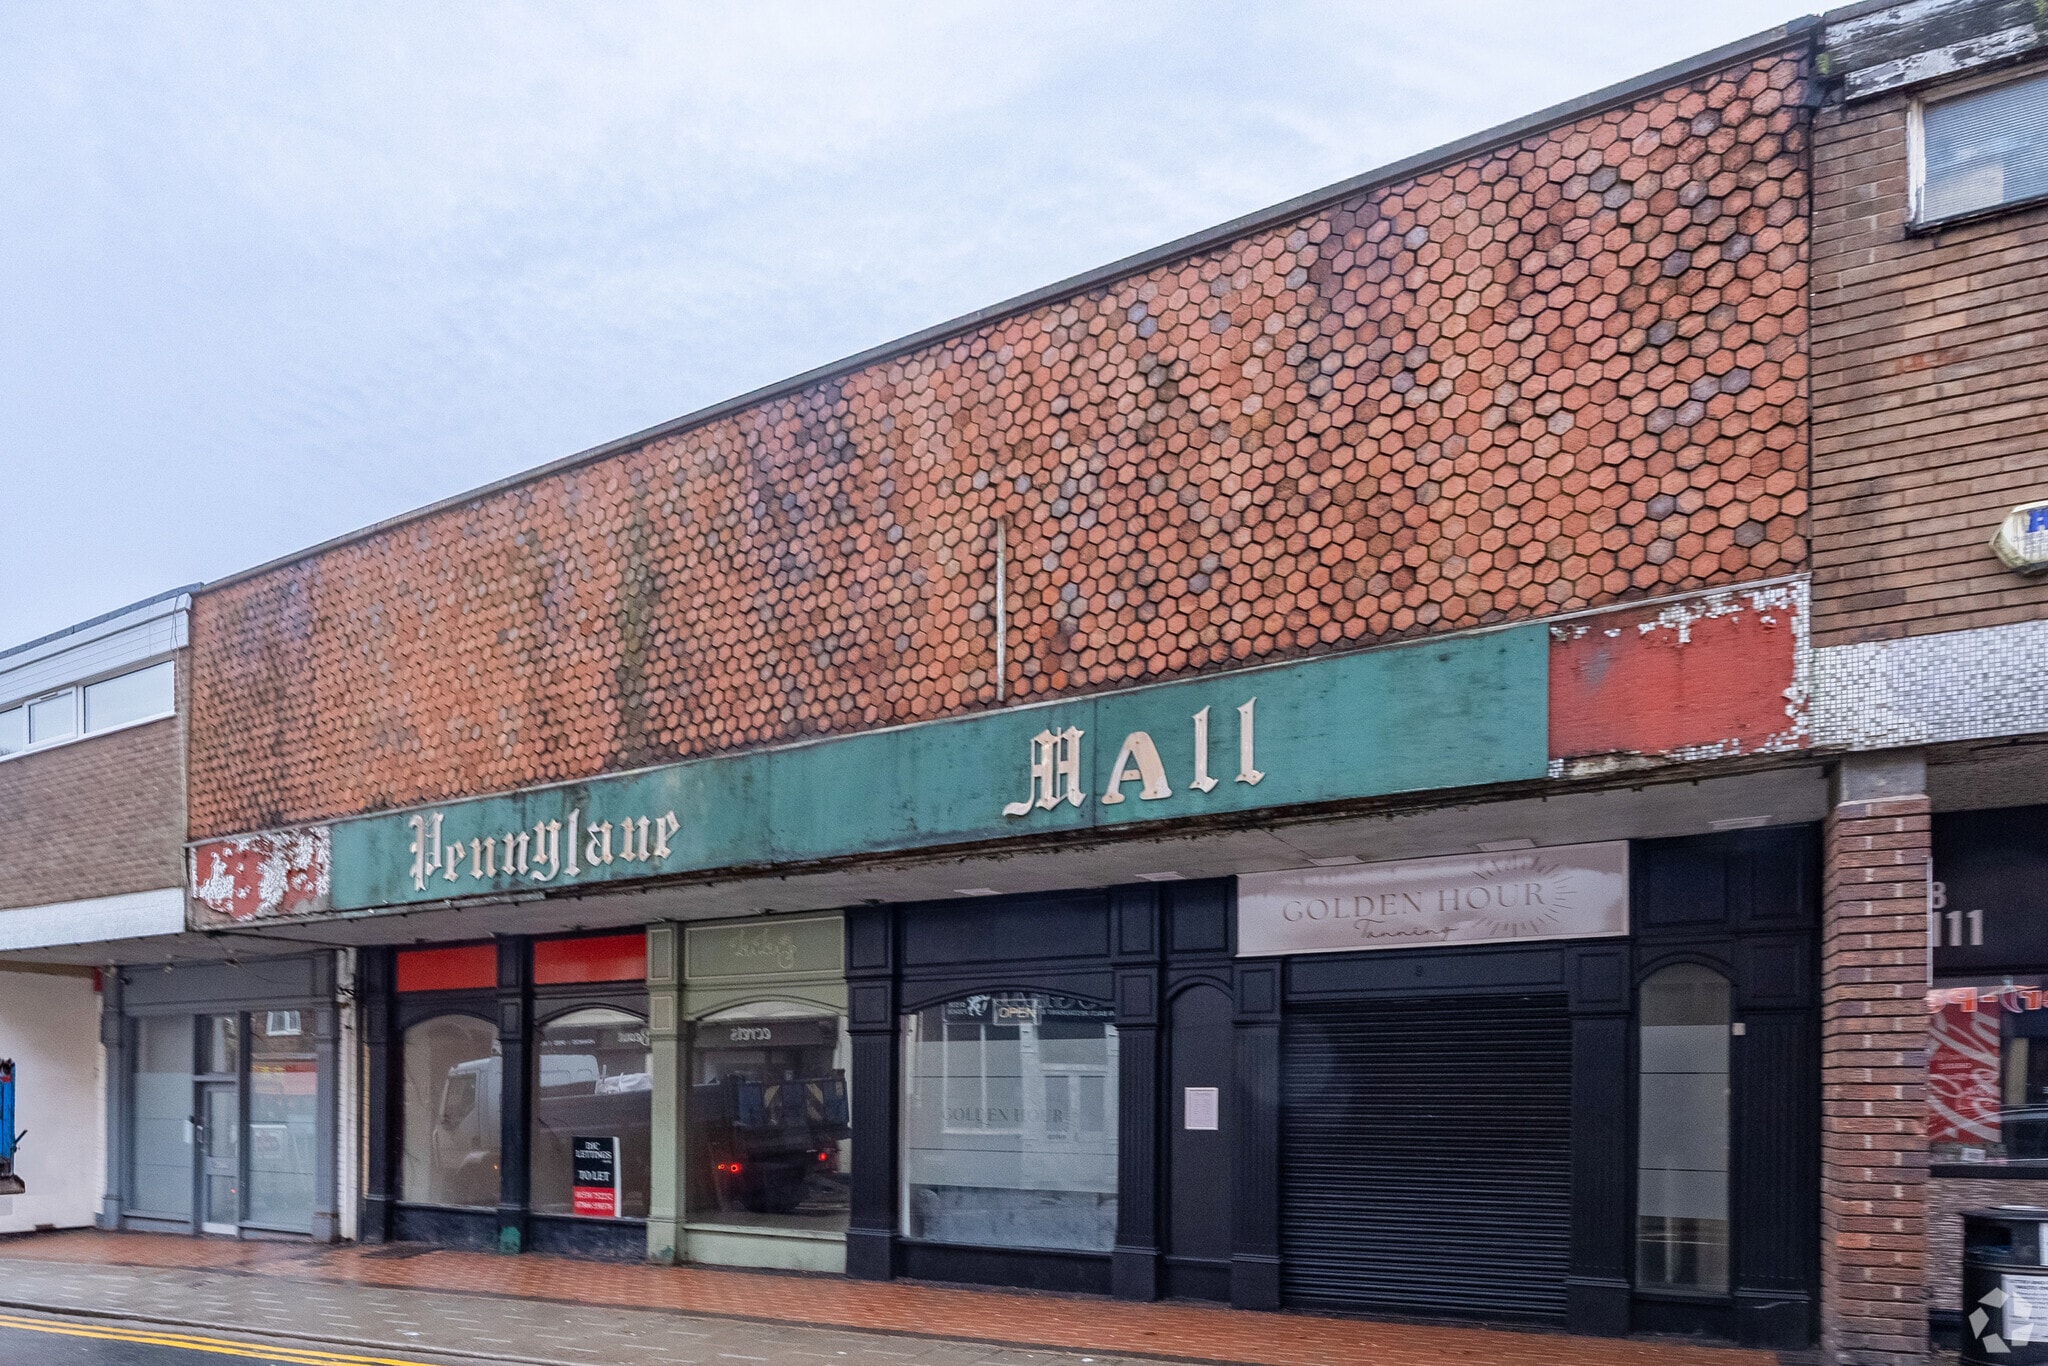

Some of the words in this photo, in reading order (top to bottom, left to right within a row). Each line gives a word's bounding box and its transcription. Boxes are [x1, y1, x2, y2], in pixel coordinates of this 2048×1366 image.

[408, 808, 682, 892] Pennylane
[1282, 892, 1423, 922] GOLDEN
[1437, 882, 1546, 912] HOUR
[1353, 918, 1459, 942] Tanning
[999, 1006, 1037, 1019] OPEN
[575, 1149, 613, 1159] LETTINGS
[578, 1169, 592, 1181] TO
[591, 1170, 611, 1182] LET
